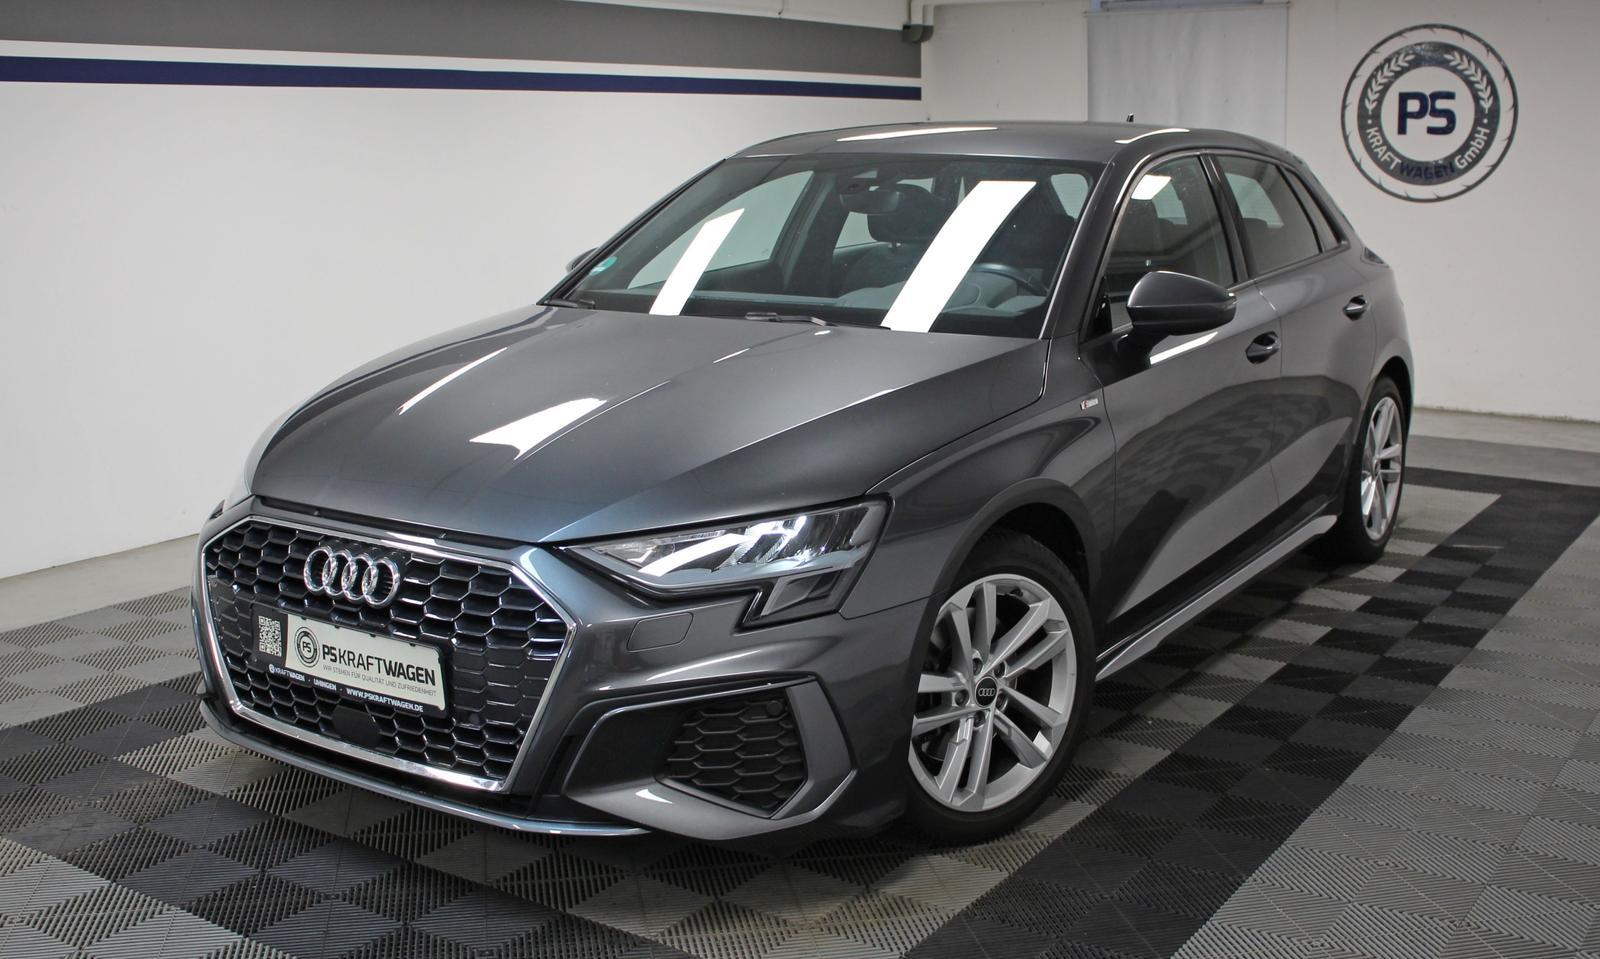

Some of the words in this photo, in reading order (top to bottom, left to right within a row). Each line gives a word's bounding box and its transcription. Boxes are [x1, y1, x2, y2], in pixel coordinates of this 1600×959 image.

[1397, 90, 1456, 136] PS
[1454, 128, 1490, 169] GmbH
[302, 641, 312, 653] PS
[386, 680, 396, 688] UND
[346, 687, 424, 712] WWW.PSKRAFTWAGEN.DE
